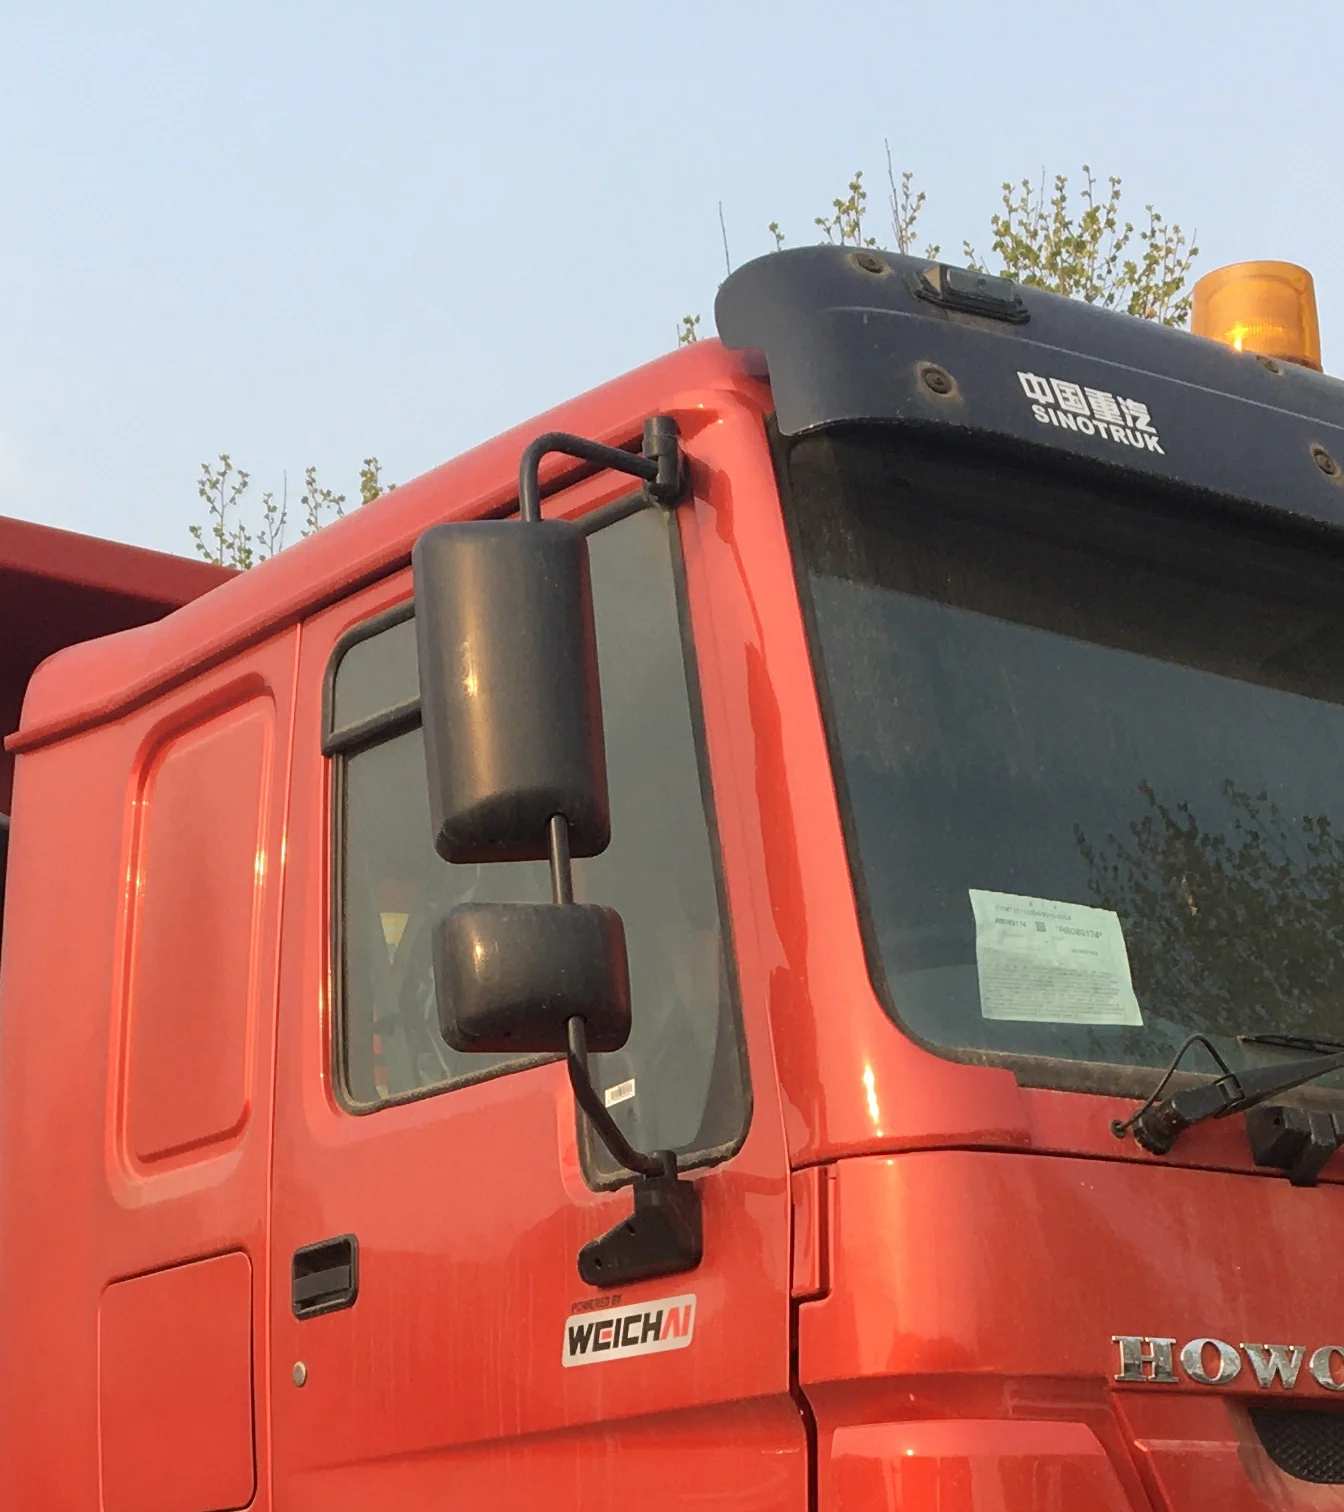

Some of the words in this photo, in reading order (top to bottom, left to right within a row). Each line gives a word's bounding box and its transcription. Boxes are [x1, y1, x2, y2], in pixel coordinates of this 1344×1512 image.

[1017, 371, 1157, 434] 中国重汽
[1031, 404, 1166, 455] SINOTRUK
[568, 1304, 693, 1357] WEICHAI
